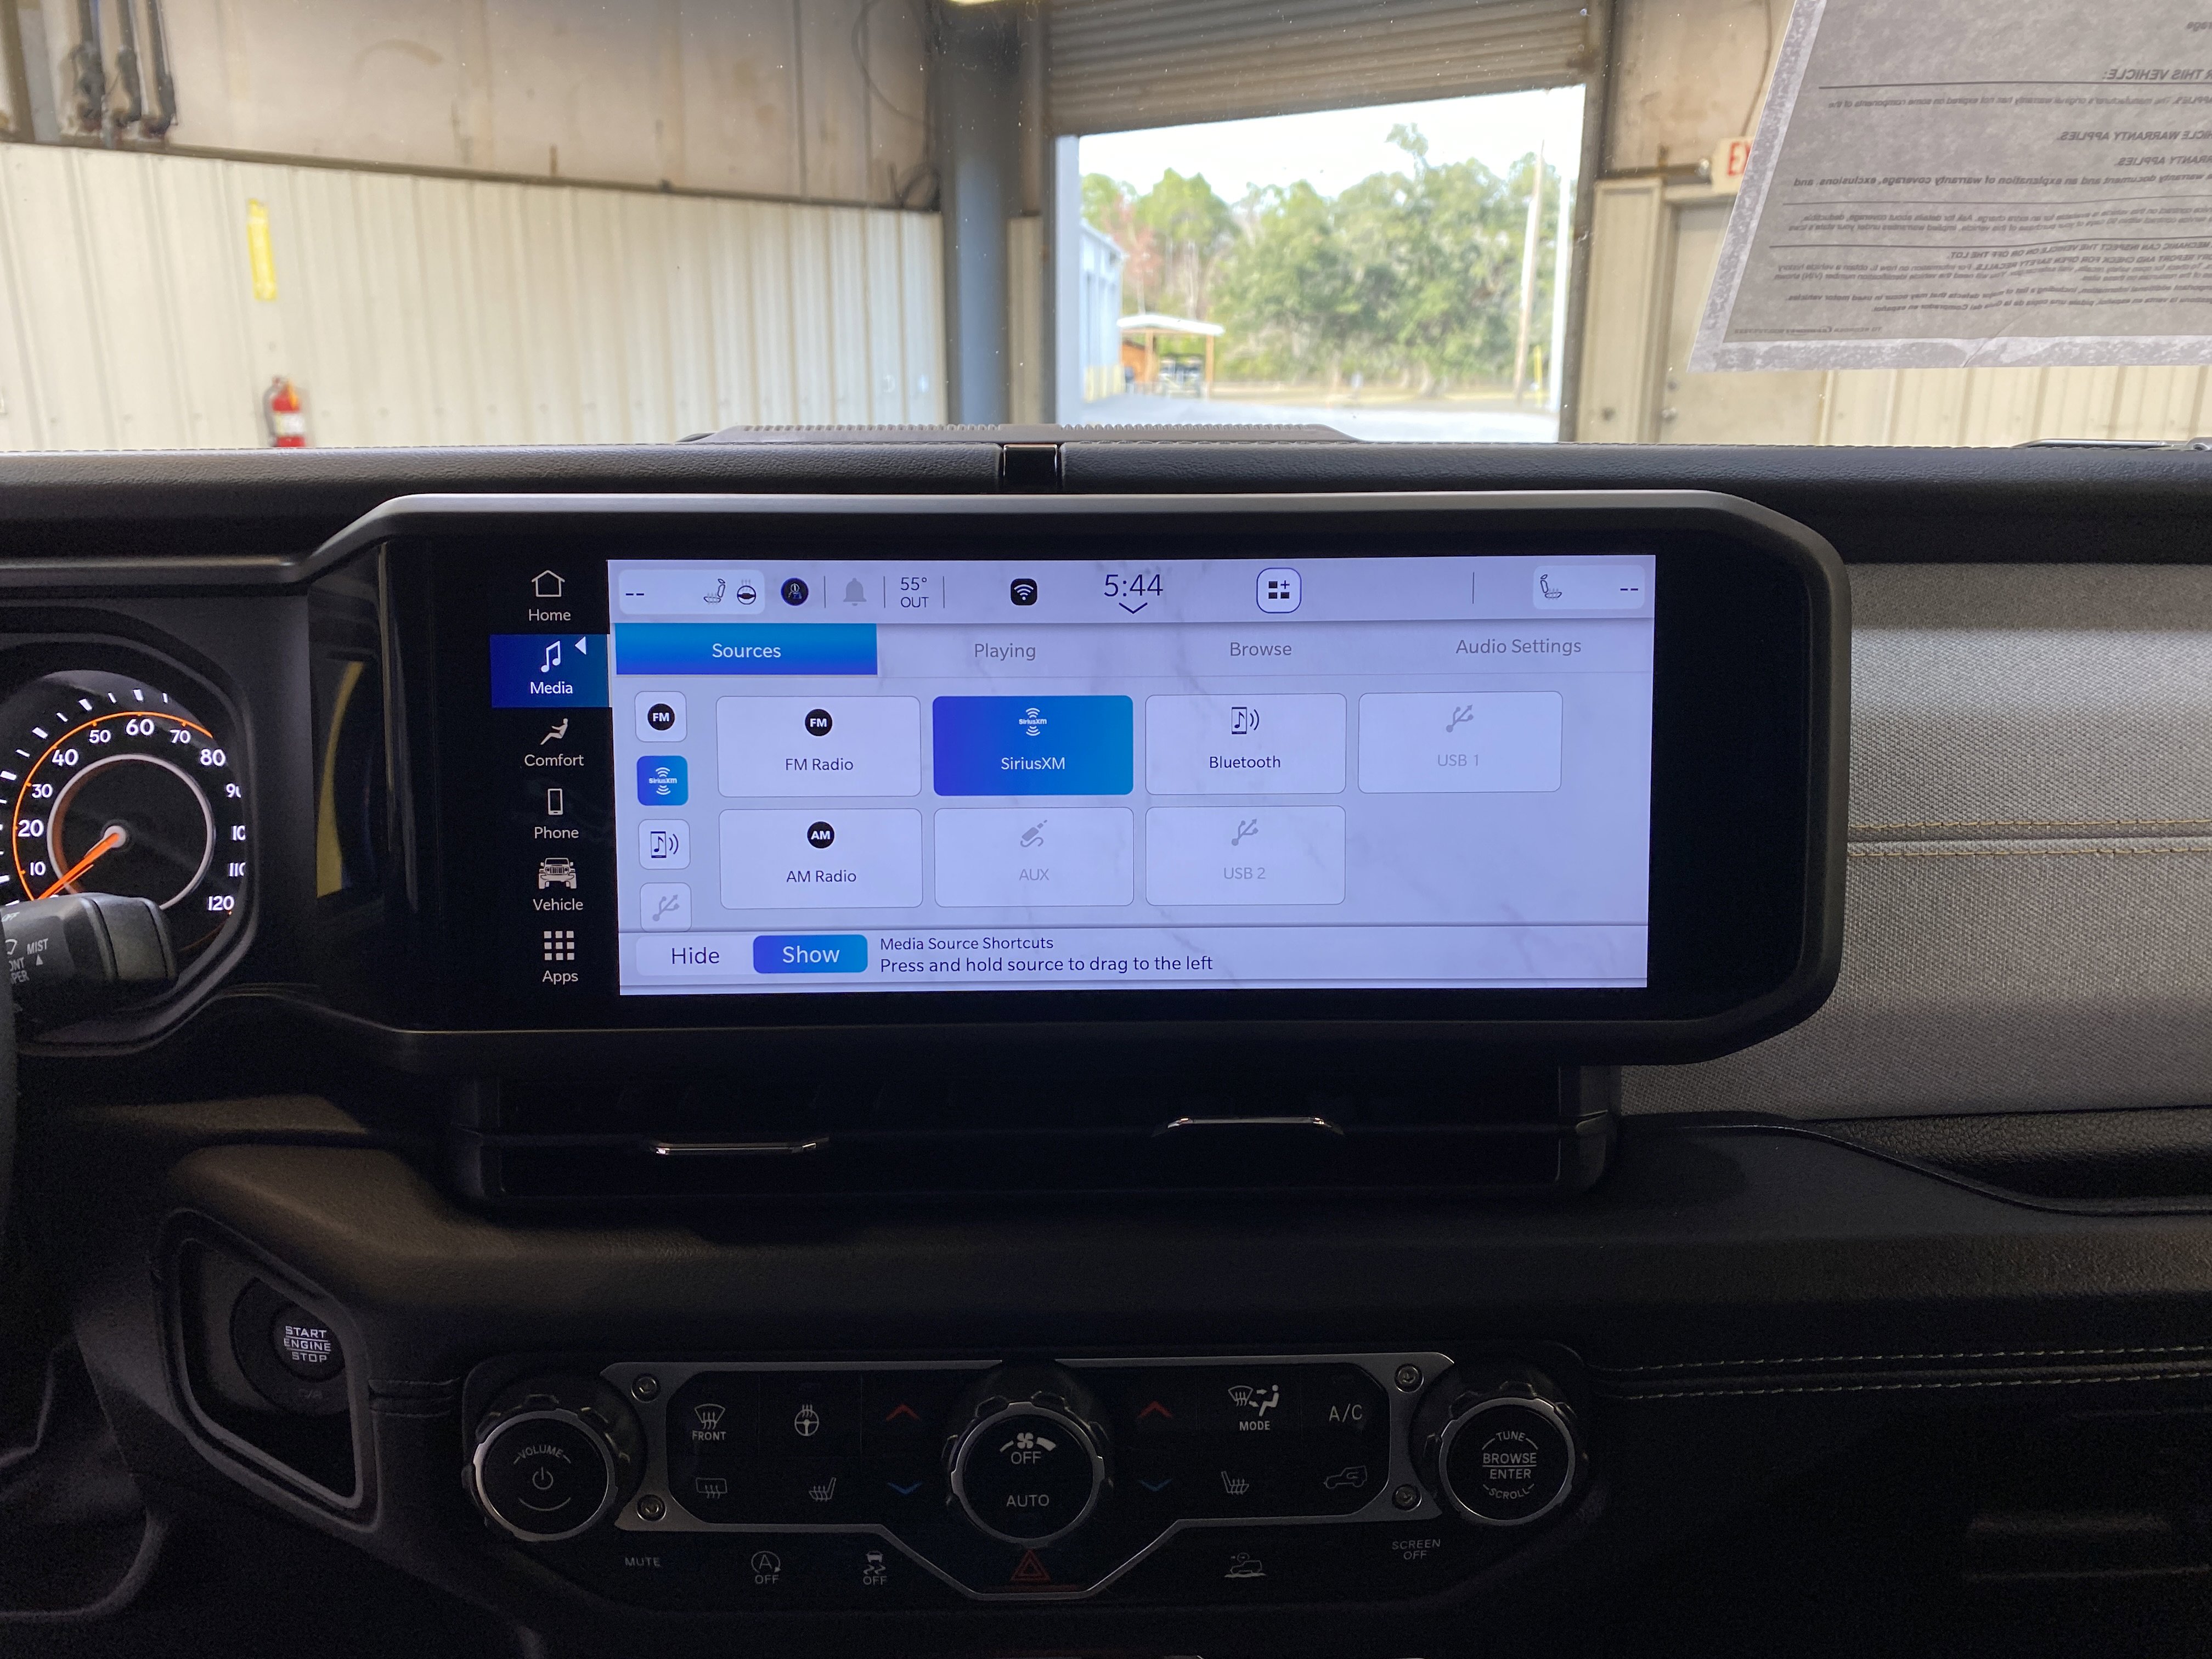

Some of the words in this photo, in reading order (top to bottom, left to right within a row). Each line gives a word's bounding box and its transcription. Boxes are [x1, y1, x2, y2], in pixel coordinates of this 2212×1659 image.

[900, 577, 928, 591] 55°
[1104, 574, 1163, 597] 5:44
[900, 597, 929, 608] OUT
[529, 610, 571, 622] Home
[712, 644, 781, 658] Sources
[974, 644, 1036, 661] Playing
[1231, 642, 1292, 656] Browse
[1456, 639, 1506, 653] Audio
[1511, 639, 1582, 656] Settings
[530, 681, 573, 695] Media
[653, 713, 669, 722] FM
[810, 719, 827, 727] FM
[125, 718, 155, 736] 60
[89, 729, 112, 743] 50
[170, 729, 193, 744] 70
[52, 748, 79, 766] 40
[200, 748, 226, 767] 80
[524, 754, 584, 766] Comfort
[1001, 757, 1065, 770] SiriusXM
[1209, 755, 1281, 769] Bluetooth
[1437, 754, 1467, 767] USB
[1474, 754, 1480, 766] 1
[786, 759, 807, 771] FM
[812, 758, 854, 771] Radio
[32, 783, 53, 799] 30
[18, 819, 44, 837] 20
[534, 827, 579, 839] Phone
[811, 831, 831, 839] AM
[30, 862, 46, 876] 10
[1019, 868, 1049, 881] AUX
[1223, 867, 1253, 880] USB
[1257, 867, 1266, 879] 2
[787, 871, 810, 883] AM
[815, 870, 856, 883] Radio
[207, 895, 235, 911] 120
[533, 899, 583, 911] Vehicle
[27, 938, 48, 955] MIST
[881, 938, 924, 950] Media
[928, 938, 979, 950] Source
[983, 937, 1053, 950] Shortcuts
[672, 947, 720, 964] Hide
[782, 946, 840, 963] Show
[881, 960, 924, 972] Press
[929, 958, 960, 972] and
[966, 957, 1002, 971] hold
[1008, 960, 1063, 971] source
[1068, 958, 1085, 971] to
[1090, 957, 1127, 973] drag
[1133, 958, 1149, 970] to
[1155, 957, 1181, 970] the
[1187, 956, 1213, 970] left
[543, 970, 578, 984] Apps
[285, 1325, 327, 1339] START
[283, 1338, 331, 1352] ENGINE
[292, 1352, 327, 1363] STOP
[1329, 1403, 1363, 1423] A/C
[1239, 1420, 1271, 1430] MODE
[692, 1431, 726, 1441] FRONT
[1496, 1430, 1526, 1442] TUNE
[517, 1444, 564, 1459] VOLUME
[1011, 1451, 1042, 1464] OFF
[1483, 1452, 1537, 1464] BROWSE
[1489, 1469, 1531, 1480] ENTER
[1488, 1487, 1530, 1500] SCROLL
[1006, 1494, 1049, 1508] AUTO
[1392, 1539, 1441, 1550] SCREEN
[1403, 1550, 1427, 1560] OFF
[625, 1557, 661, 1567] MUTE
[754, 1575, 781, 1584] OFF
[863, 1576, 887, 1585] OFF
